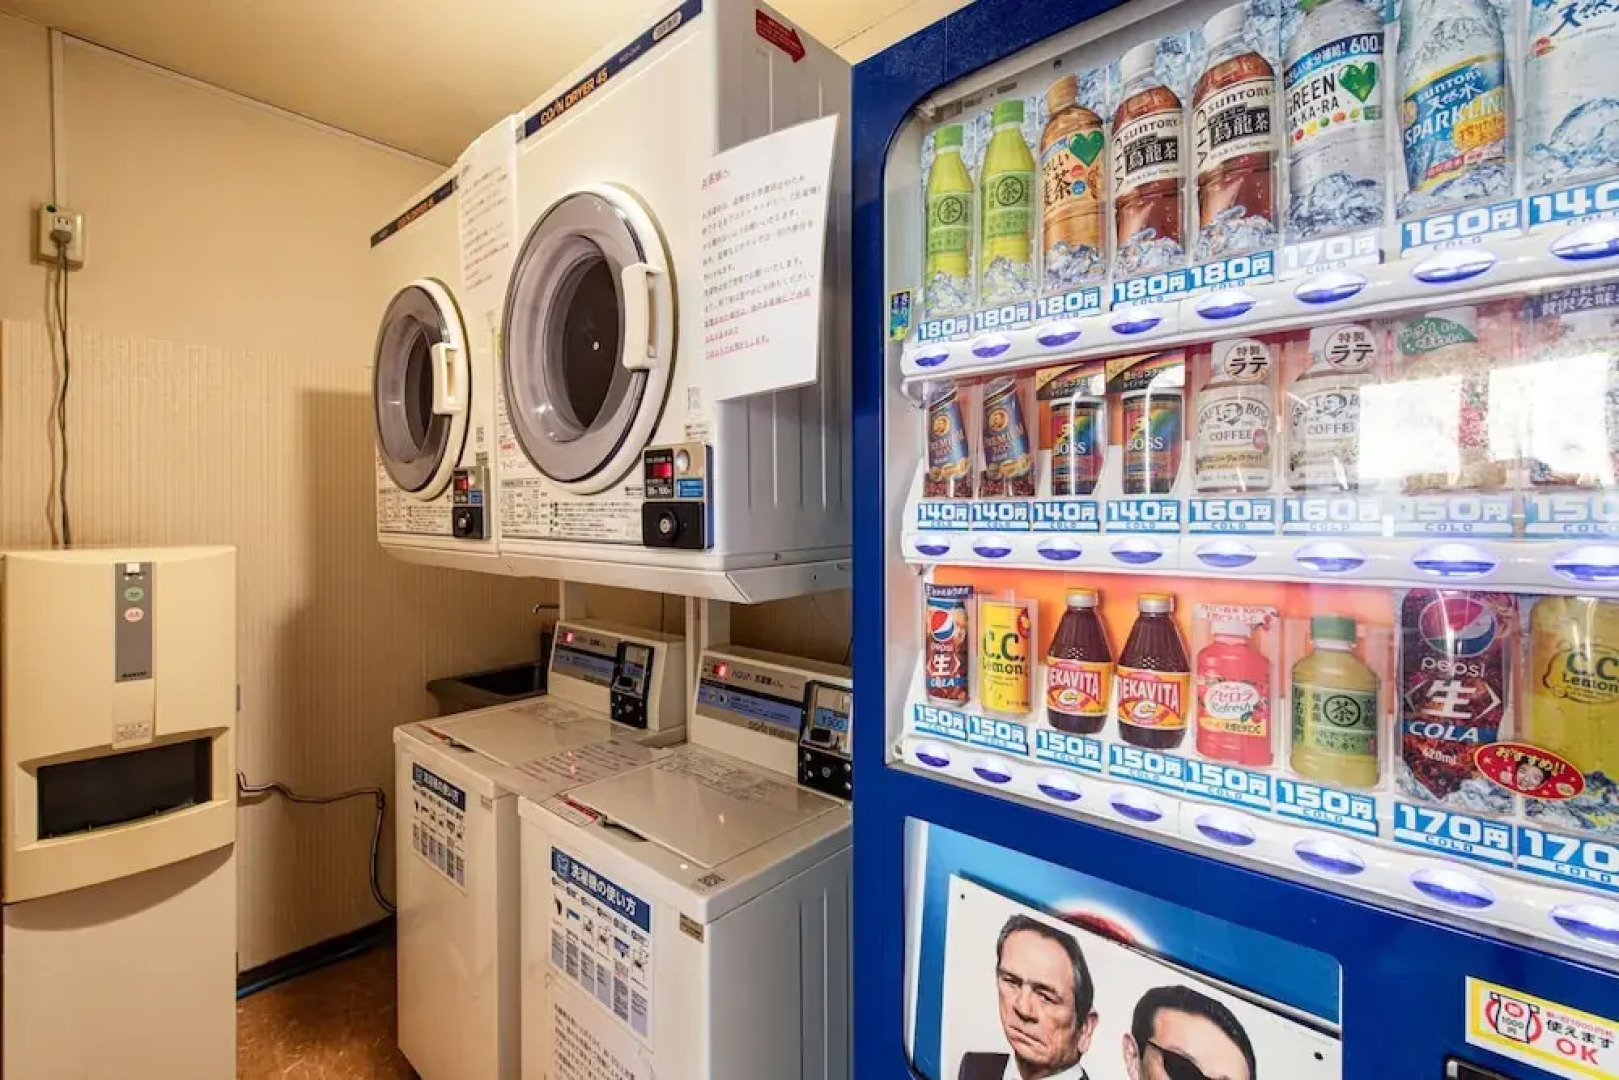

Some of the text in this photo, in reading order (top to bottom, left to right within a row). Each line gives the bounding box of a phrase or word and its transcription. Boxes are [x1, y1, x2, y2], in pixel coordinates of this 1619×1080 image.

[1350, 35, 1379, 55] 600
[1208, 87, 1270, 113] SUNTORY
[1286, 73, 1335, 116] GREEN
[1123, 119, 1178, 142] SUNTORY
[1214, 112, 1269, 145] 烏龍茶
[1127, 142, 1177, 174] 烏龍茶
[1404, 204, 1519, 246] 160円
[1284, 233, 1378, 269] 170円
[1194, 254, 1274, 285] 180円
[1115, 271, 1190, 301] 180円
[975, 303, 1031, 330] 180円
[1037, 289, 1101, 318] 180円
[919, 316, 971, 342] 180円
[1230, 357, 1268, 376] ラテ
[1330, 344, 1374, 364] ラテ
[1209, 430, 1253, 441] COFFEE
[919, 503, 967, 521] 140円
[973, 503, 1027, 521] 140円
[1033, 503, 1097, 521] 140円
[1107, 502, 1177, 521] 140円
[1190, 499, 1273, 521] 160円
[1285, 499, 1381, 522] 160円
[1126, 521, 1156, 529] COLD
[1210, 521, 1246, 530] COLD
[1308, 523, 1351, 531] COLD
[1424, 524, 1474, 533] COLD
[983, 630, 1025, 661] C.C.
[931, 653, 951, 676] 生
[1420, 656, 1486, 678] pepsi
[1048, 667, 1100, 698] EKAVITA
[1562, 672, 1619, 694] Lemon
[1327, 698, 1359, 726] 茶
[1420, 679, 1477, 720] 生
[915, 705, 966, 731] 150円
[970, 716, 1026, 742] 150円
[1408, 720, 1479, 743] COLA
[1038, 731, 1100, 760] 150円
[1112, 745, 1183, 777] 150円
[1188, 761, 1269, 796] 150円
[1279, 781, 1374, 820] 150円
[1302, 807, 1343, 822] COLD
[1399, 804, 1509, 850] 170円
[1425, 834, 1474, 852] COLD
[1523, 829, 1619, 873] 170
[1554, 864, 1612, 884] COLD
[569, 862, 637, 919] 洗濯機の使い方
[1501, 1016, 1525, 1030] 1000
[1546, 1018, 1615, 1050] 使えます
[1555, 1037, 1600, 1066] OK
